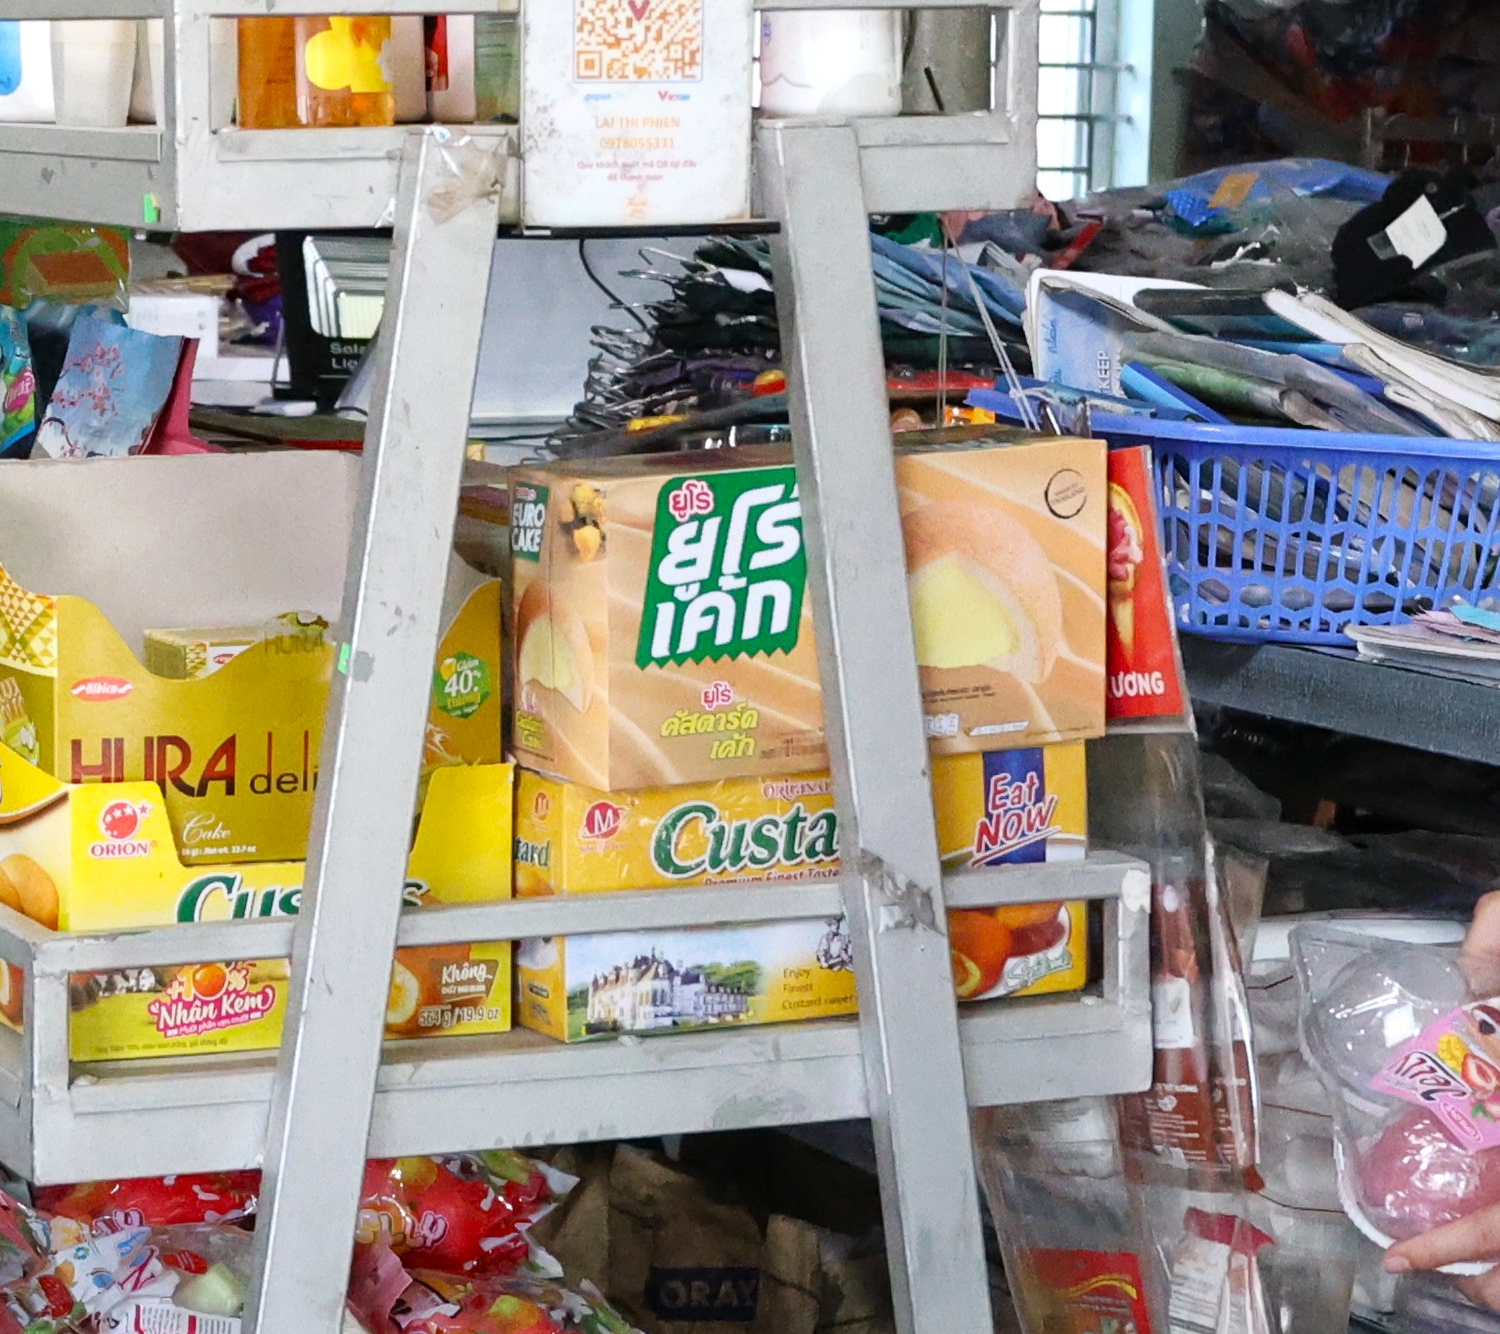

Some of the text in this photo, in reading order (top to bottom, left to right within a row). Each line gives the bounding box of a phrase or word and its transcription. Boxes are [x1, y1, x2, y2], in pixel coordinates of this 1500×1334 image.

[1097, 350, 1110, 389] KEEP
[71, 733, 236, 798] HURA
[989, 770, 1039, 813] Eat
[975, 795, 1057, 854] NOW
[91, 842, 148, 857] ORION
[442, 960, 493, 984] Không
[221, 991, 265, 1015] Kem
